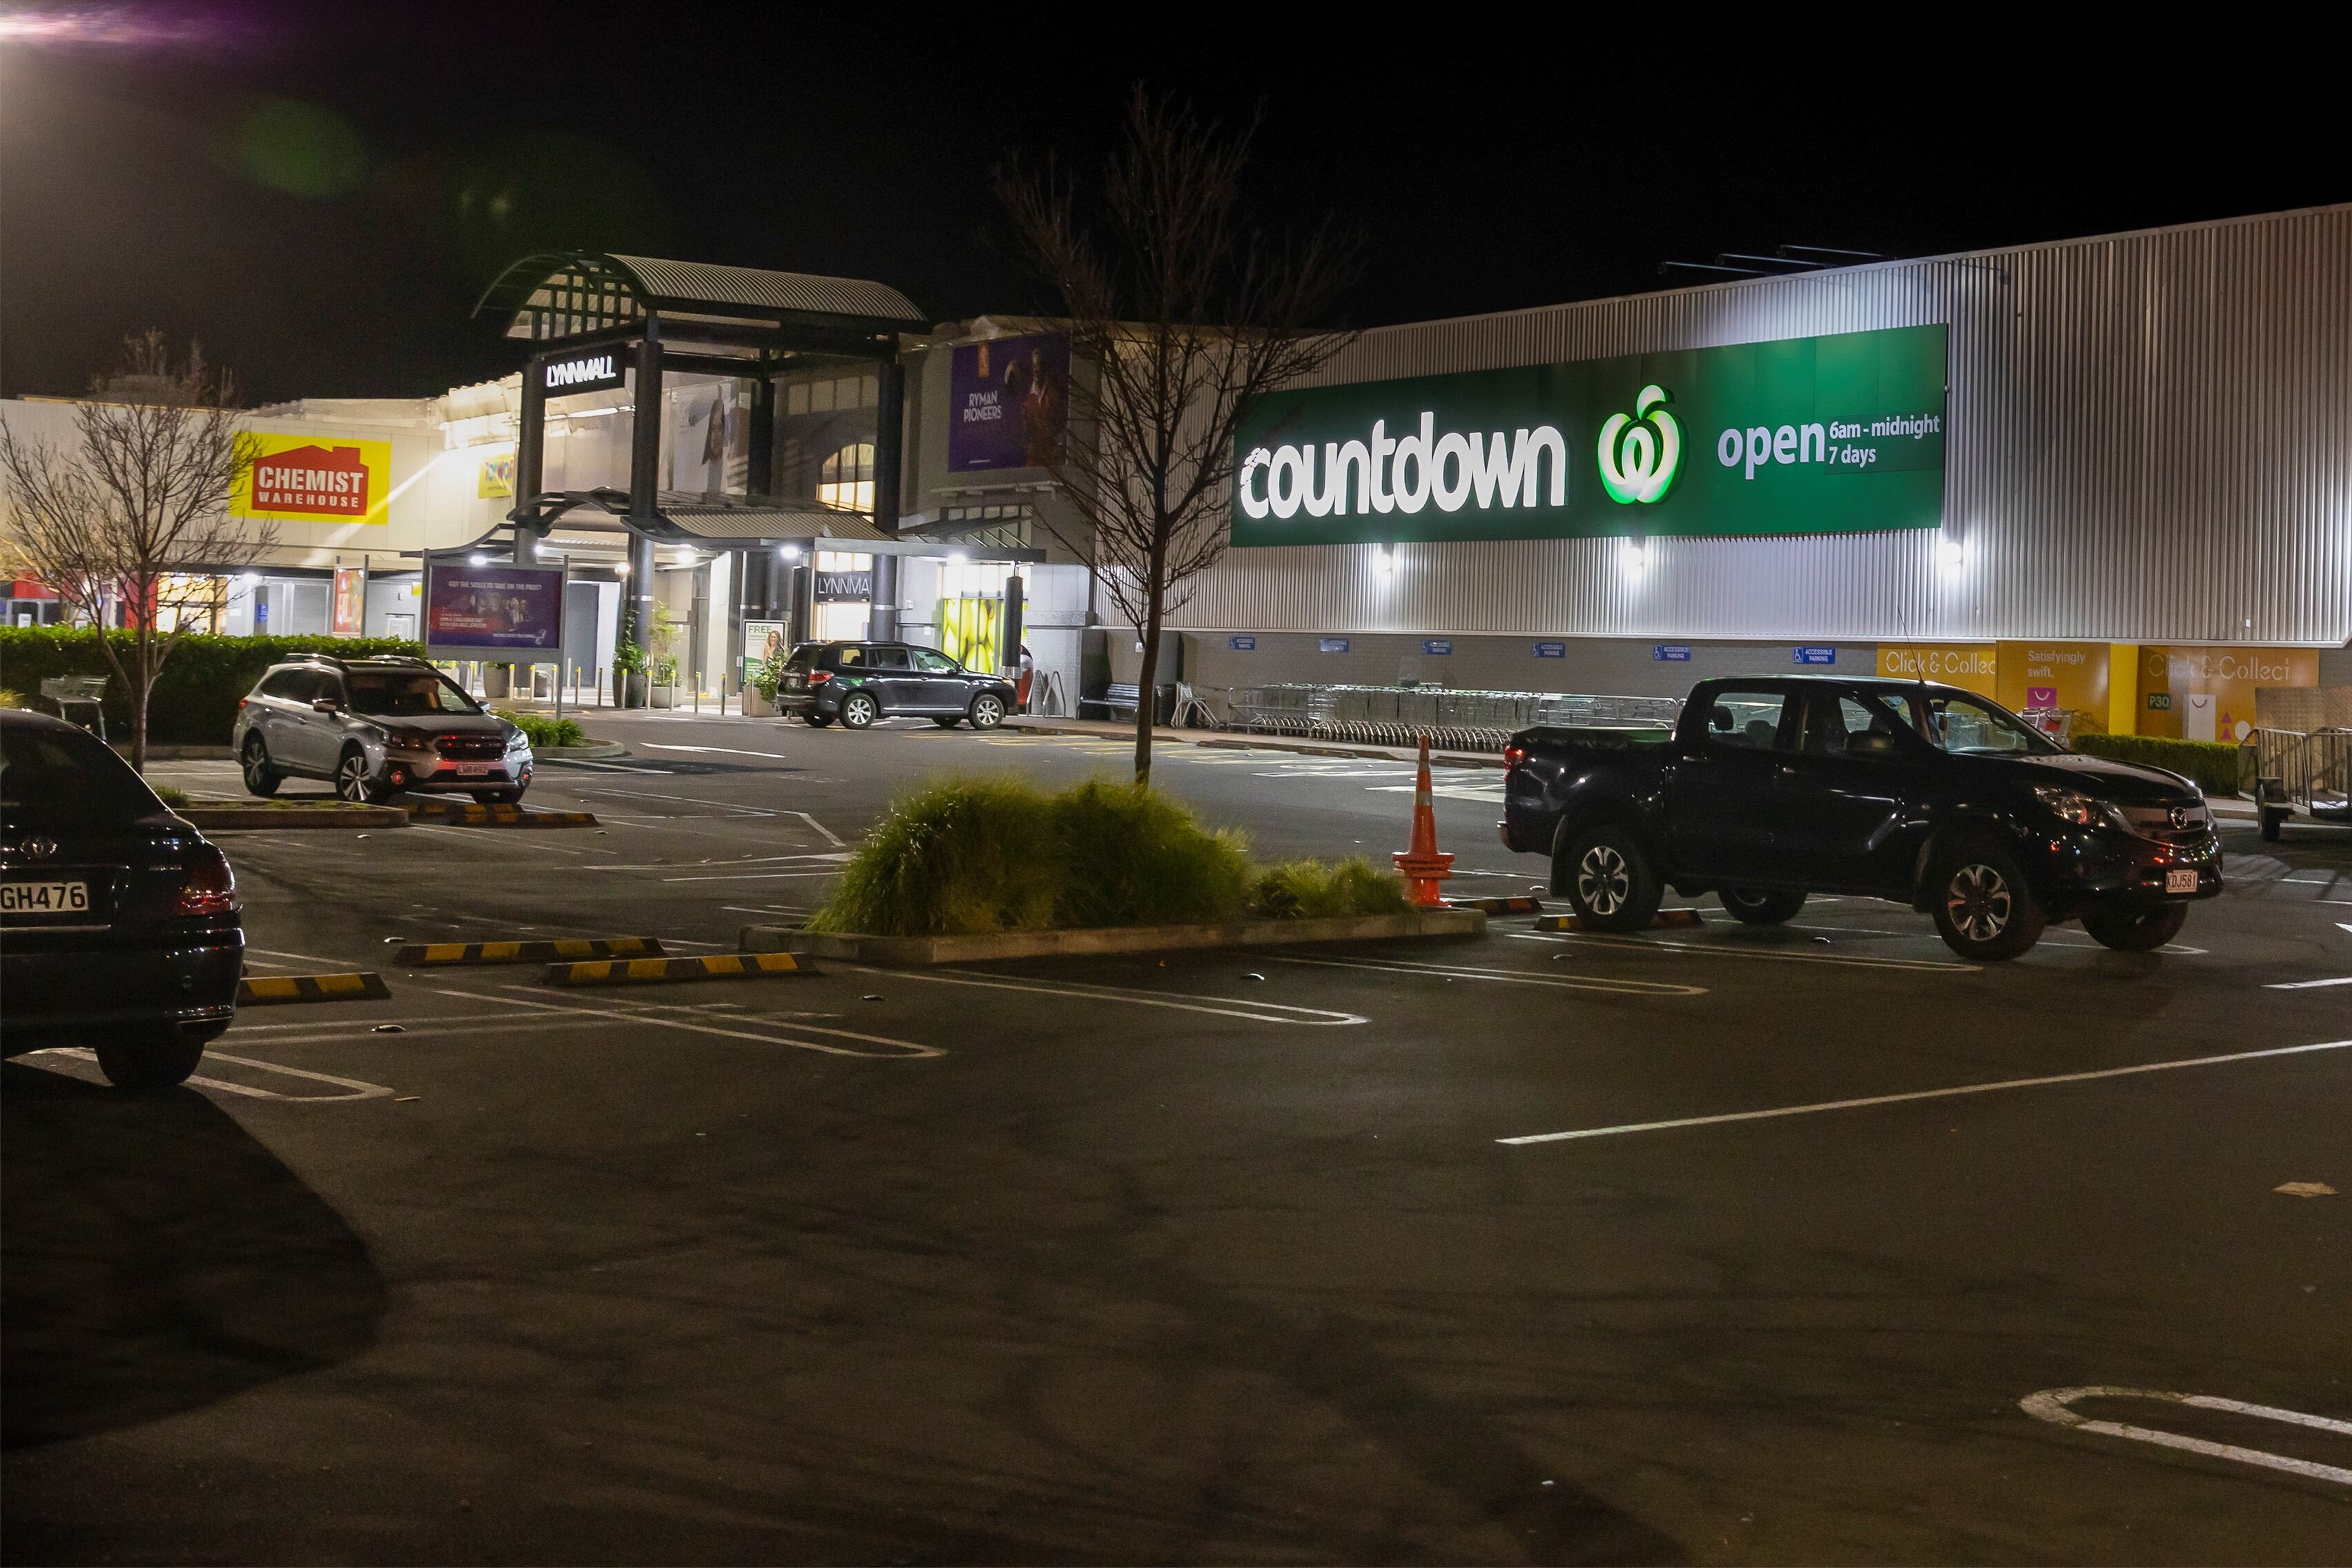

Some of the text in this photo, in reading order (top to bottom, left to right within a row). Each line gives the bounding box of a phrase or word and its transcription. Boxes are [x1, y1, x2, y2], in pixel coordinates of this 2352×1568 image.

[547, 355, 616, 387] LYNNMALL
[969, 390, 998, 407] RYMAN
[964, 406, 1002, 422] PIONEERS
[1829, 421, 1861, 440] 6am
[1871, 414, 1941, 440] midnight
[1718, 423, 1825, 480] open
[1829, 444, 1876, 468] 7 days
[1241, 412, 1566, 519] countdown
[258, 466, 364, 494] CHEMIST
[258, 491, 359, 508] WAREHOUSE
[748, 625, 772, 634] FREE
[1886, 651, 1926, 673] Click
[1930, 651, 1941, 674] &
[2028, 650, 2086, 666] Satisfyingly
[2201, 655, 2213, 679] &
[2219, 656, 2291, 680] Collect
[2027, 665, 2054, 678] swift.
[2168, 874, 2196, 888] KDJ581
[0, 886, 86, 910] GH476
